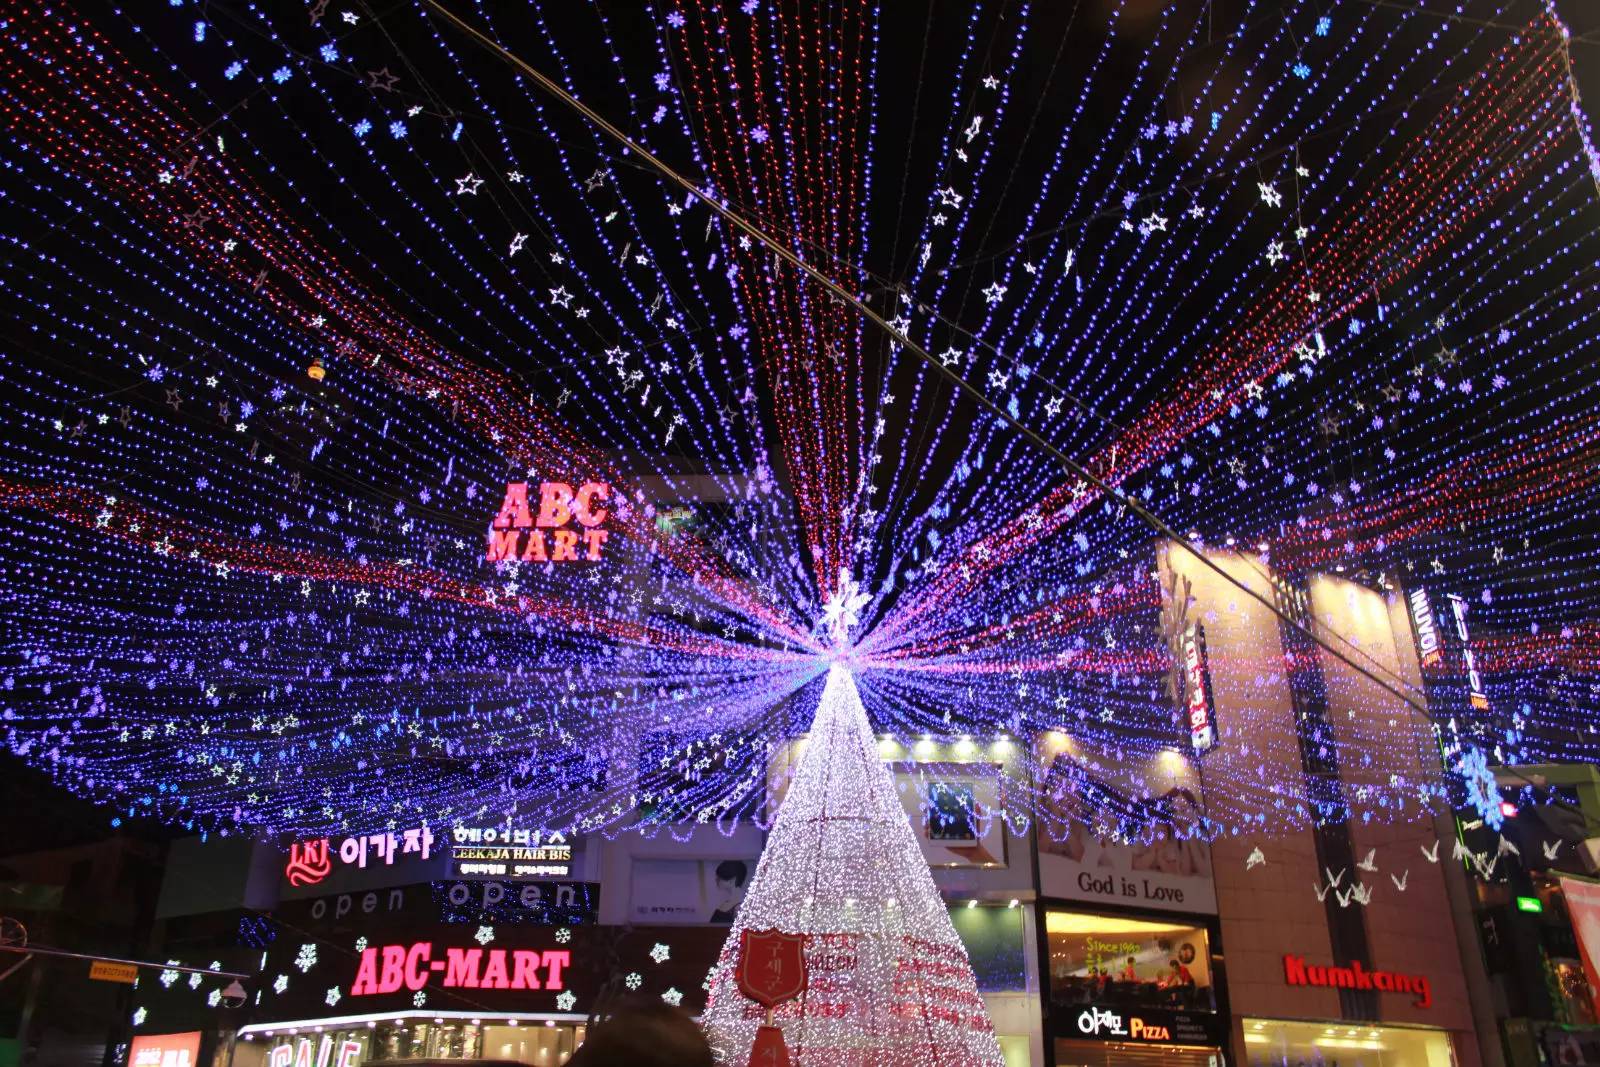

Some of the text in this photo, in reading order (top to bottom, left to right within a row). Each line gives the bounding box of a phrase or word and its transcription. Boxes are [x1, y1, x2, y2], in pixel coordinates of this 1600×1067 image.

[494, 482, 609, 528] ABC
[486, 530, 608, 562] MART
[340, 827, 434, 868] 이가자
[452, 849, 572, 861] LEEKAJA HAIR BIS
[311, 889, 403, 920] open
[449, 882, 575, 908] open
[1077, 871, 1185, 903] God is Love
[350, 942, 570, 996] ABC-MART
[763, 941, 785, 992] 구세군
[1284, 954, 1432, 1009] Kumkang
